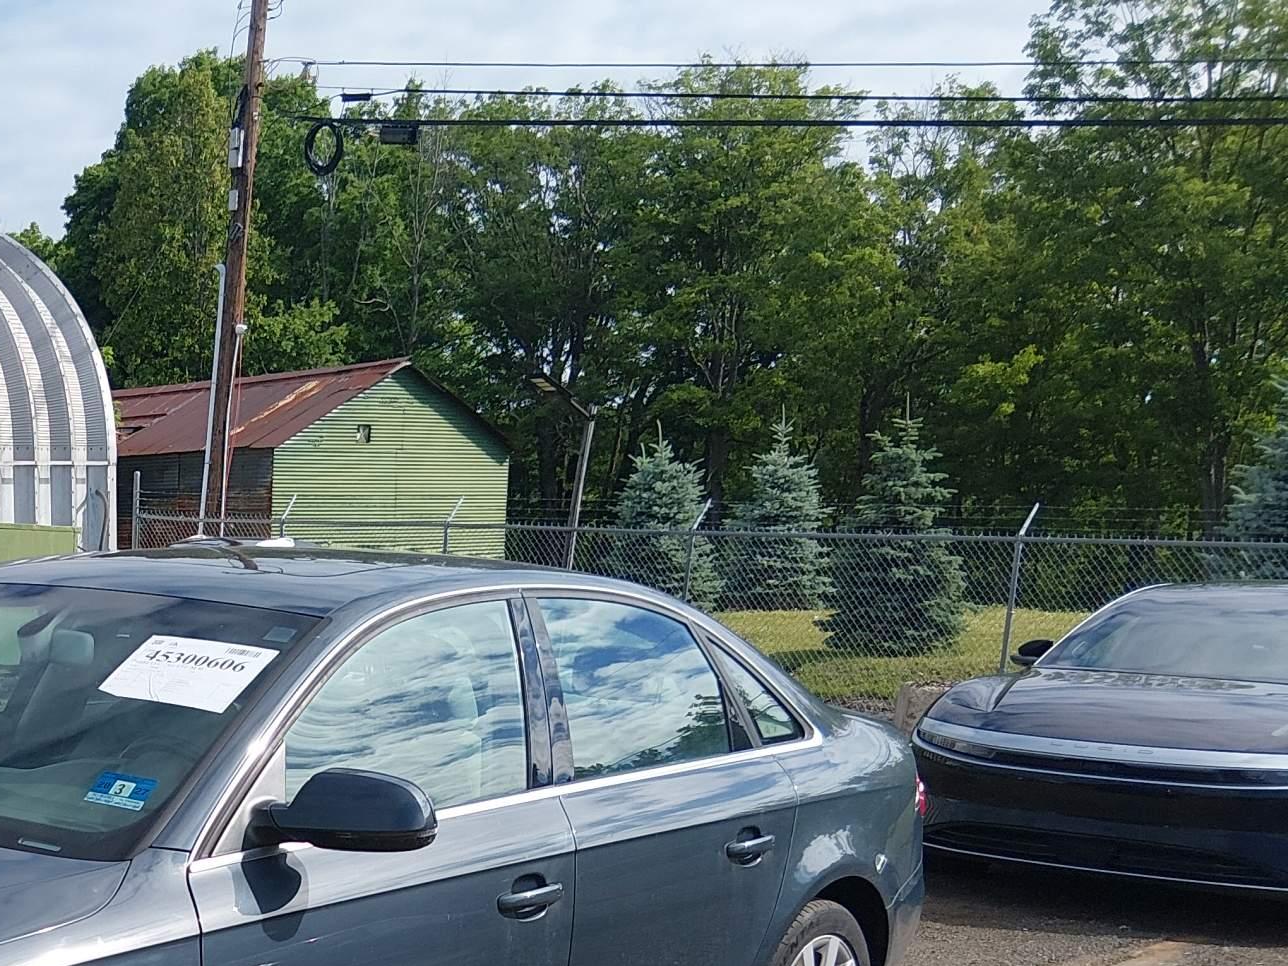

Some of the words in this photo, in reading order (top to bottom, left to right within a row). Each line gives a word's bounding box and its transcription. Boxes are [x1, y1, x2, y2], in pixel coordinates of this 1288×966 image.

[145, 650, 249, 673] 45300606
[114, 783, 126, 795] 3
[135, 787, 149, 796] 27
